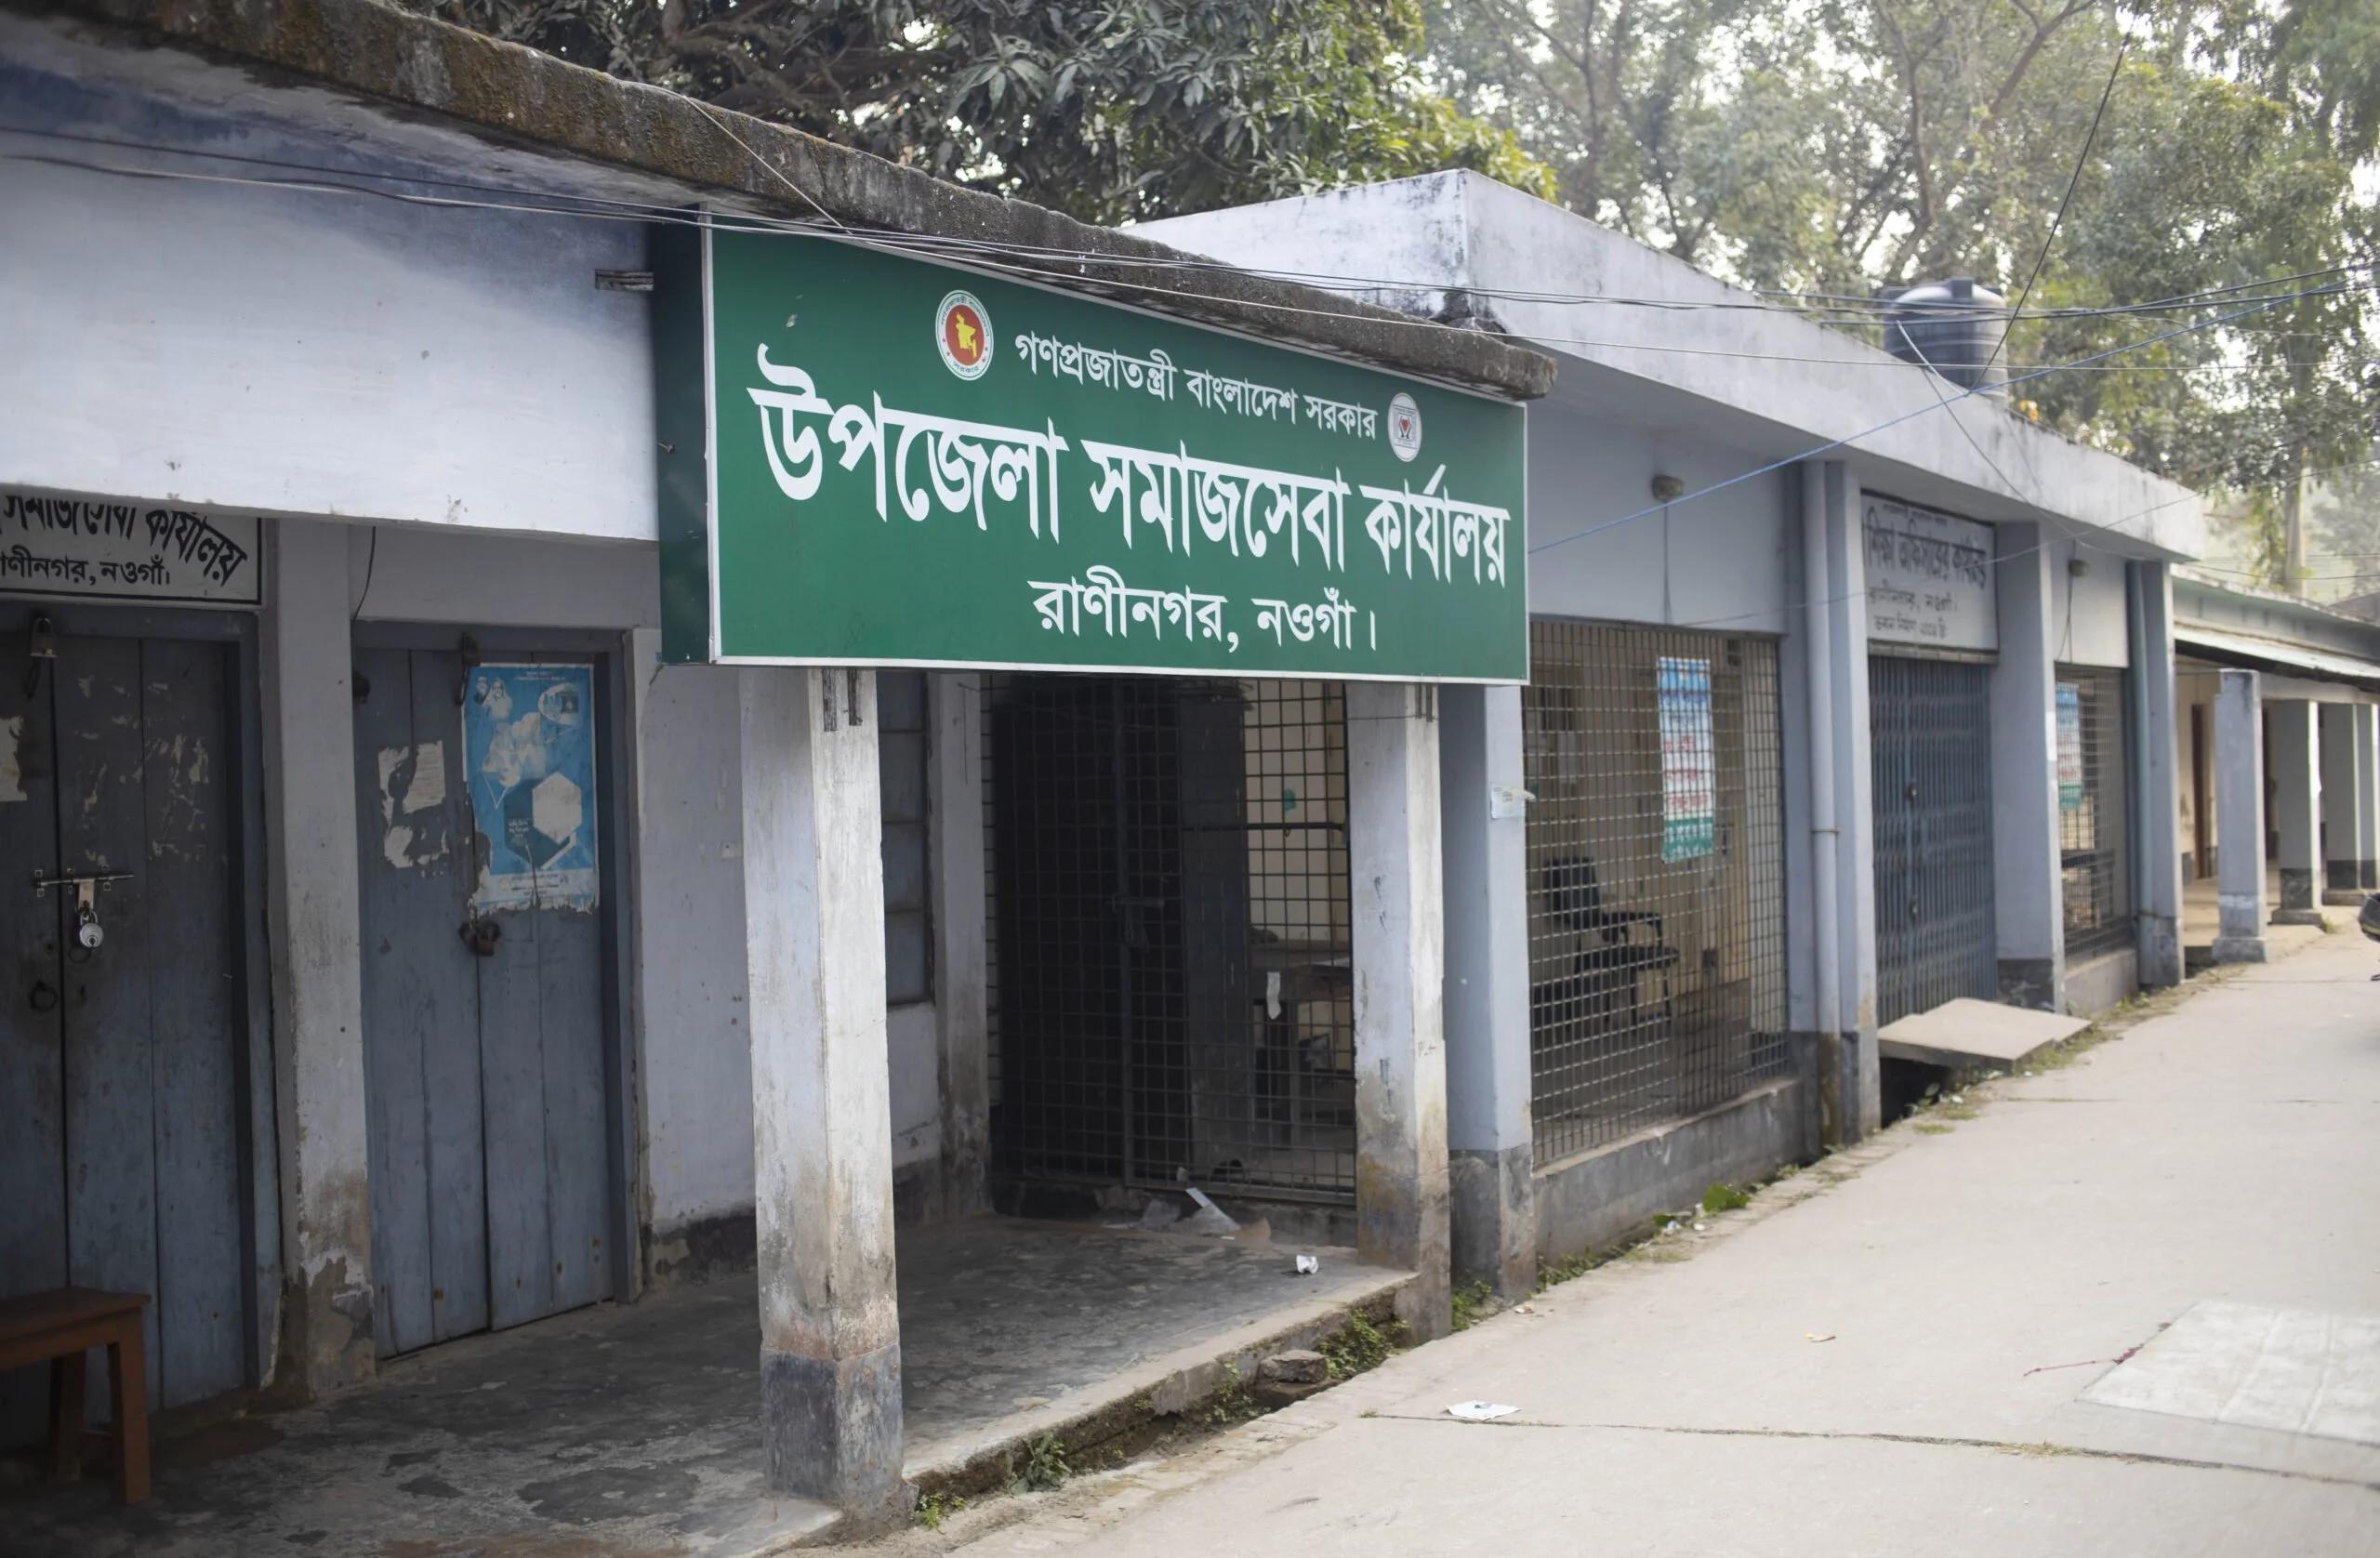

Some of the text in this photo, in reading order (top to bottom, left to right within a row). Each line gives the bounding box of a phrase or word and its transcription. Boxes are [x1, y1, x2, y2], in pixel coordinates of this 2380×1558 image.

[1015, 331, 1378, 440] গণপ্রজাতন্ত্রী বাংলাদেশ সরকার
[747, 343, 1511, 588] উপজেলা সমাজসেবা কার্যালয়
[0, 544, 97, 586] াণীনগর,
[1027, 565, 1239, 654] রাণীনগর,
